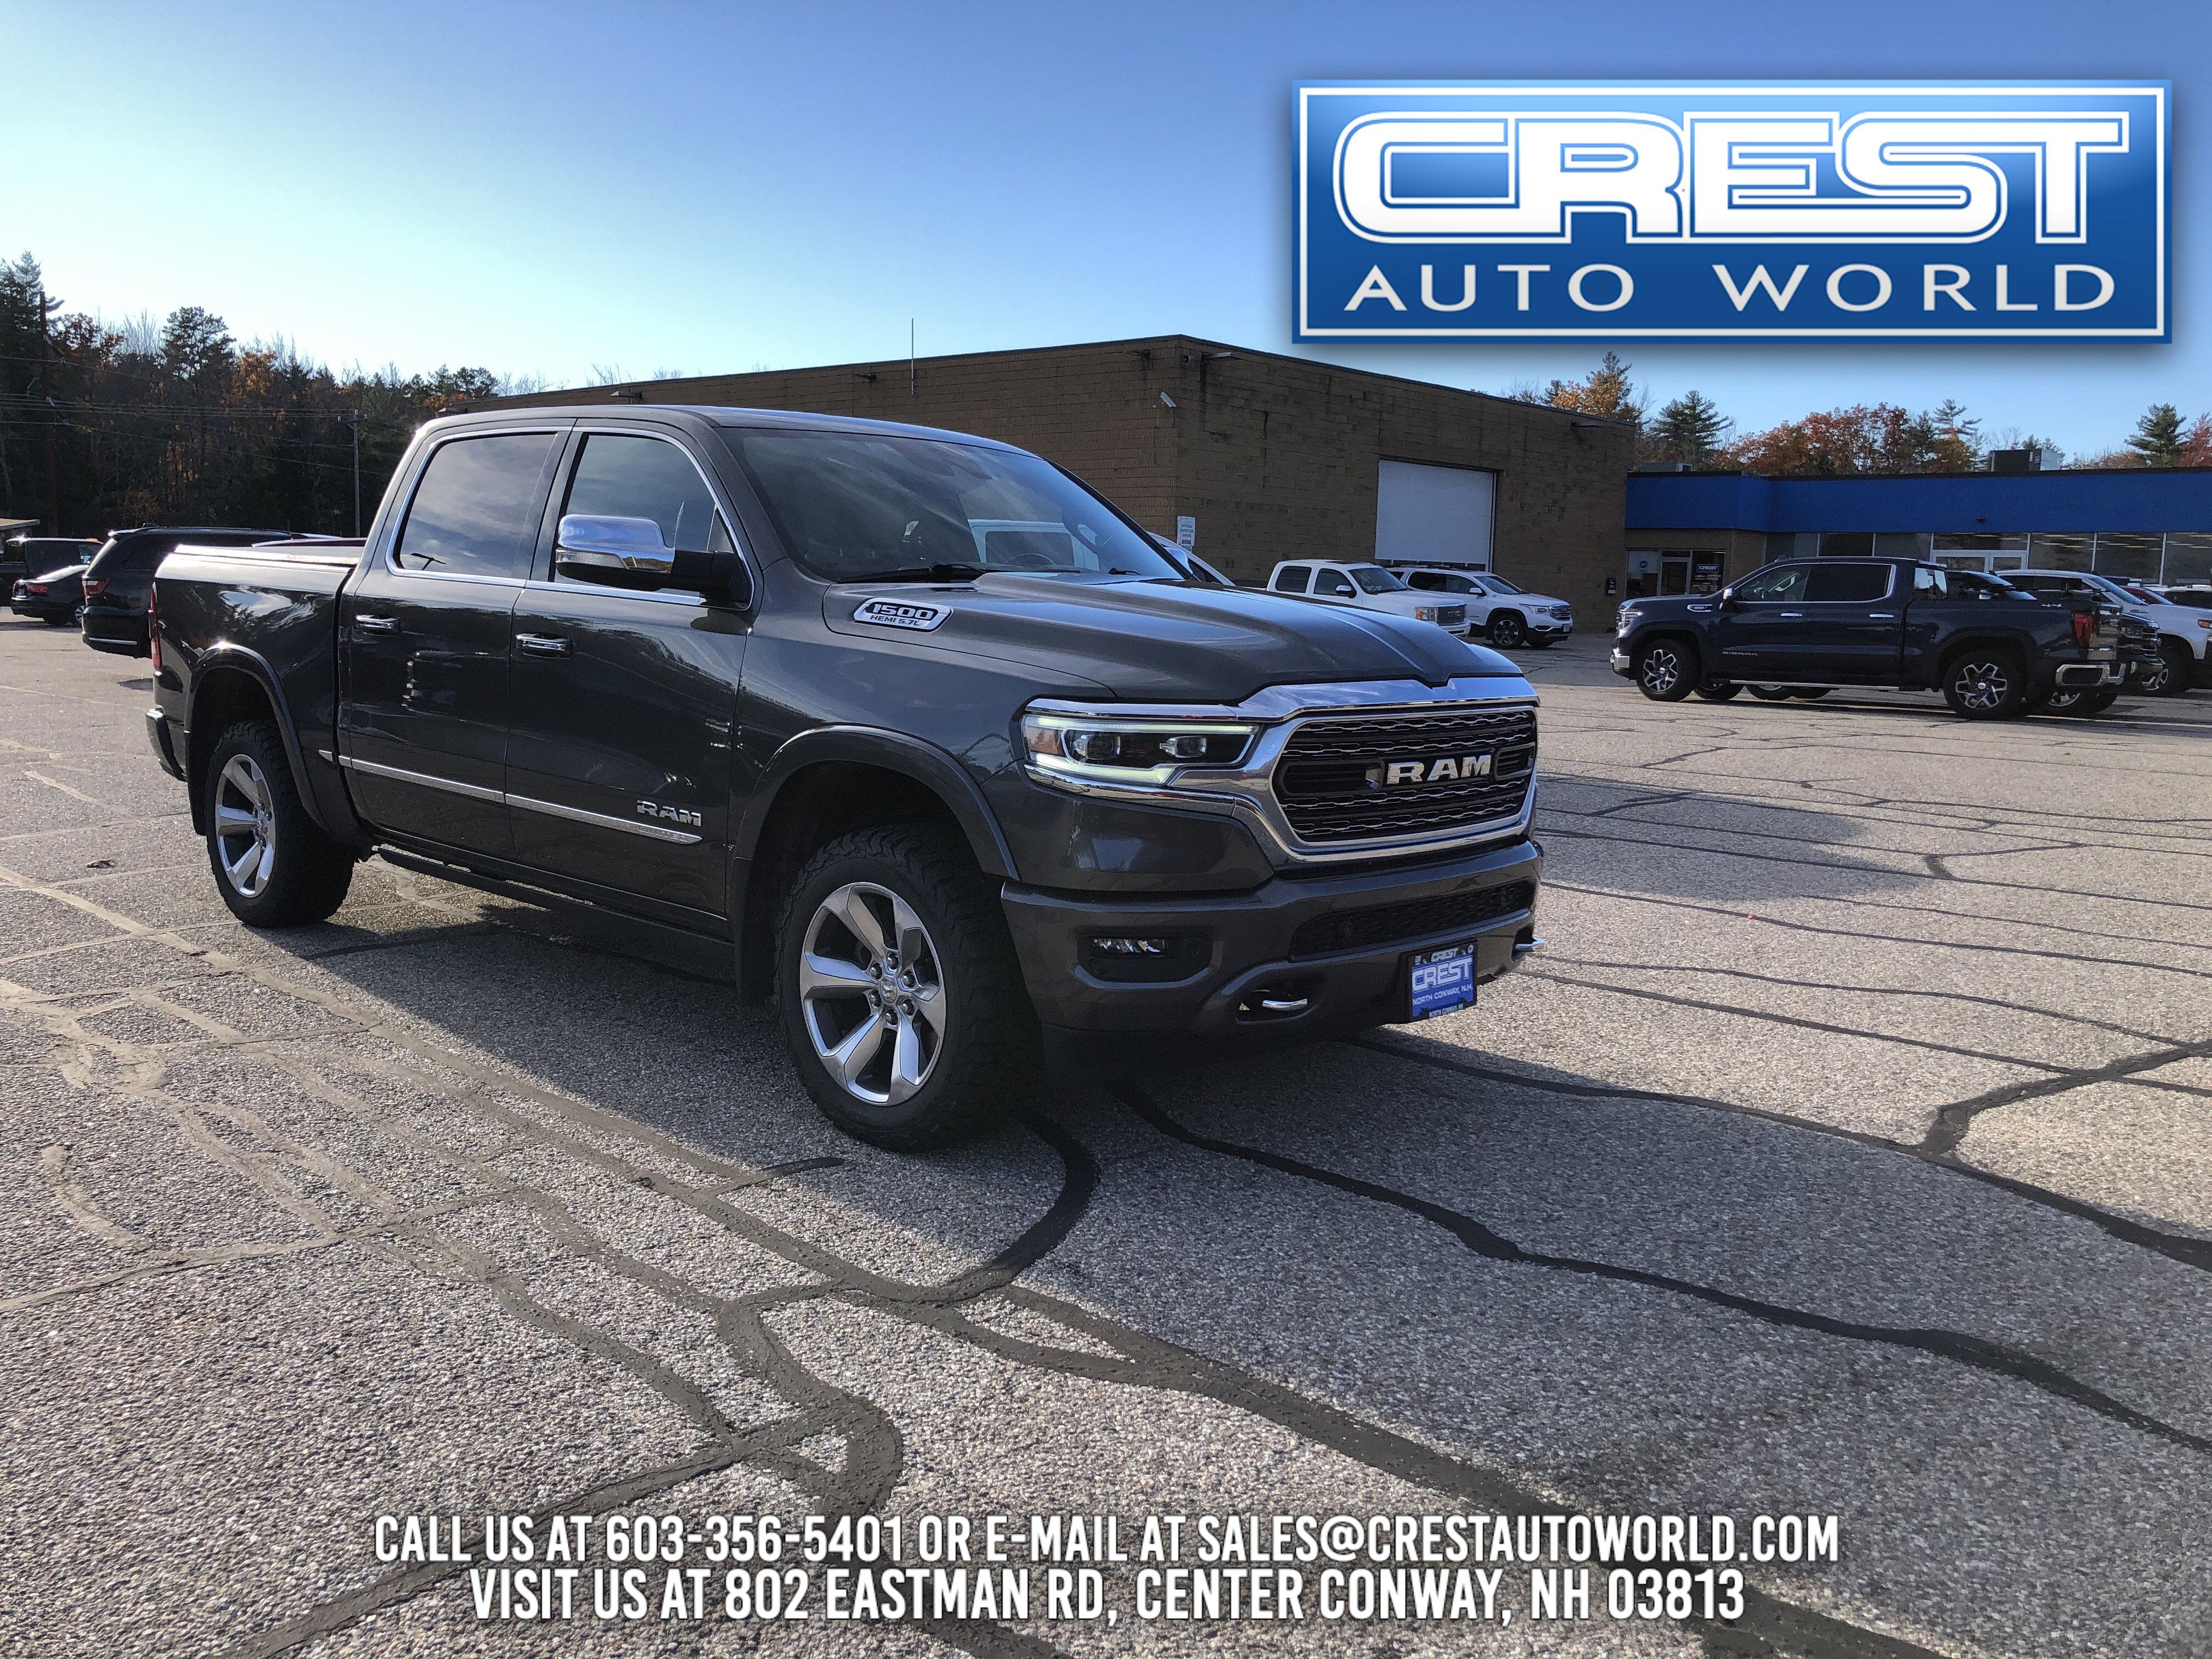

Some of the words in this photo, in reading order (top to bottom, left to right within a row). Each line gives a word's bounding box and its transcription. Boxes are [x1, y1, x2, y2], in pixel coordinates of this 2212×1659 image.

[870, 614, 897, 623] HEMI
[898, 618, 921, 626] 5.7L
[872, 603, 934, 619] 1500
[1386, 754, 1492, 785] RAM
[637, 799, 702, 827] RAM
[1431, 947, 1459, 963] CREST
[1412, 955, 1474, 993] CREST
[1412, 994, 1433, 1006] NORTH
[1434, 987, 1460, 1000] CONWAY,
